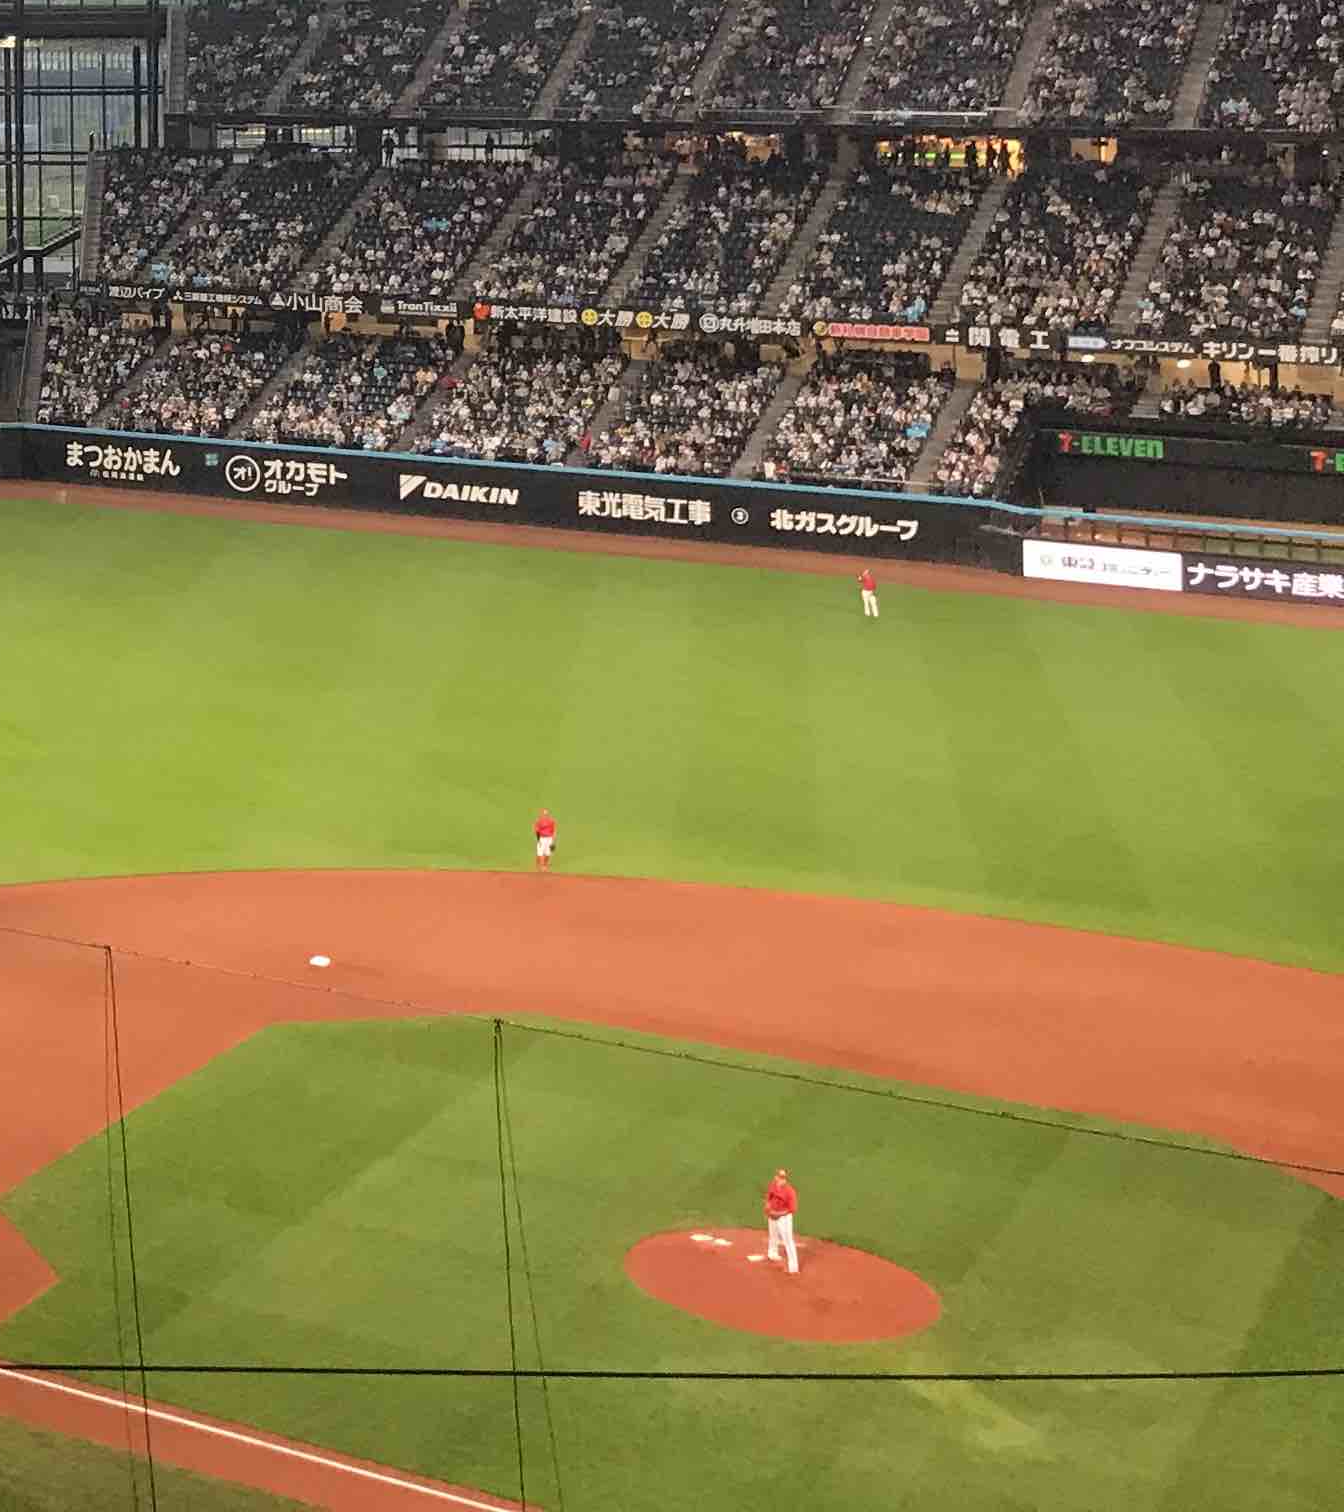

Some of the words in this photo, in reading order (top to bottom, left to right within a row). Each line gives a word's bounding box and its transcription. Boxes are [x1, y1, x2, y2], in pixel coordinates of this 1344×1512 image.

[286, 293, 365, 315] 小山商会
[489, 304, 578, 326] 新太平洋建設
[968, 327, 1051, 351] 関電工
[1201, 341, 1339, 365] キリン一番搾り
[1059, 431, 1164, 459] 7-ELEVEN
[65, 441, 182, 478] まつおかまん
[263, 458, 348, 487] オカモト
[264, 479, 320, 498] グループ
[422, 480, 520, 506] DAIKIN
[577, 489, 712, 527] 東光電気工事
[770, 508, 919, 543] 北ガスグループ
[1186, 561, 1344, 599] ナラサキ産業
